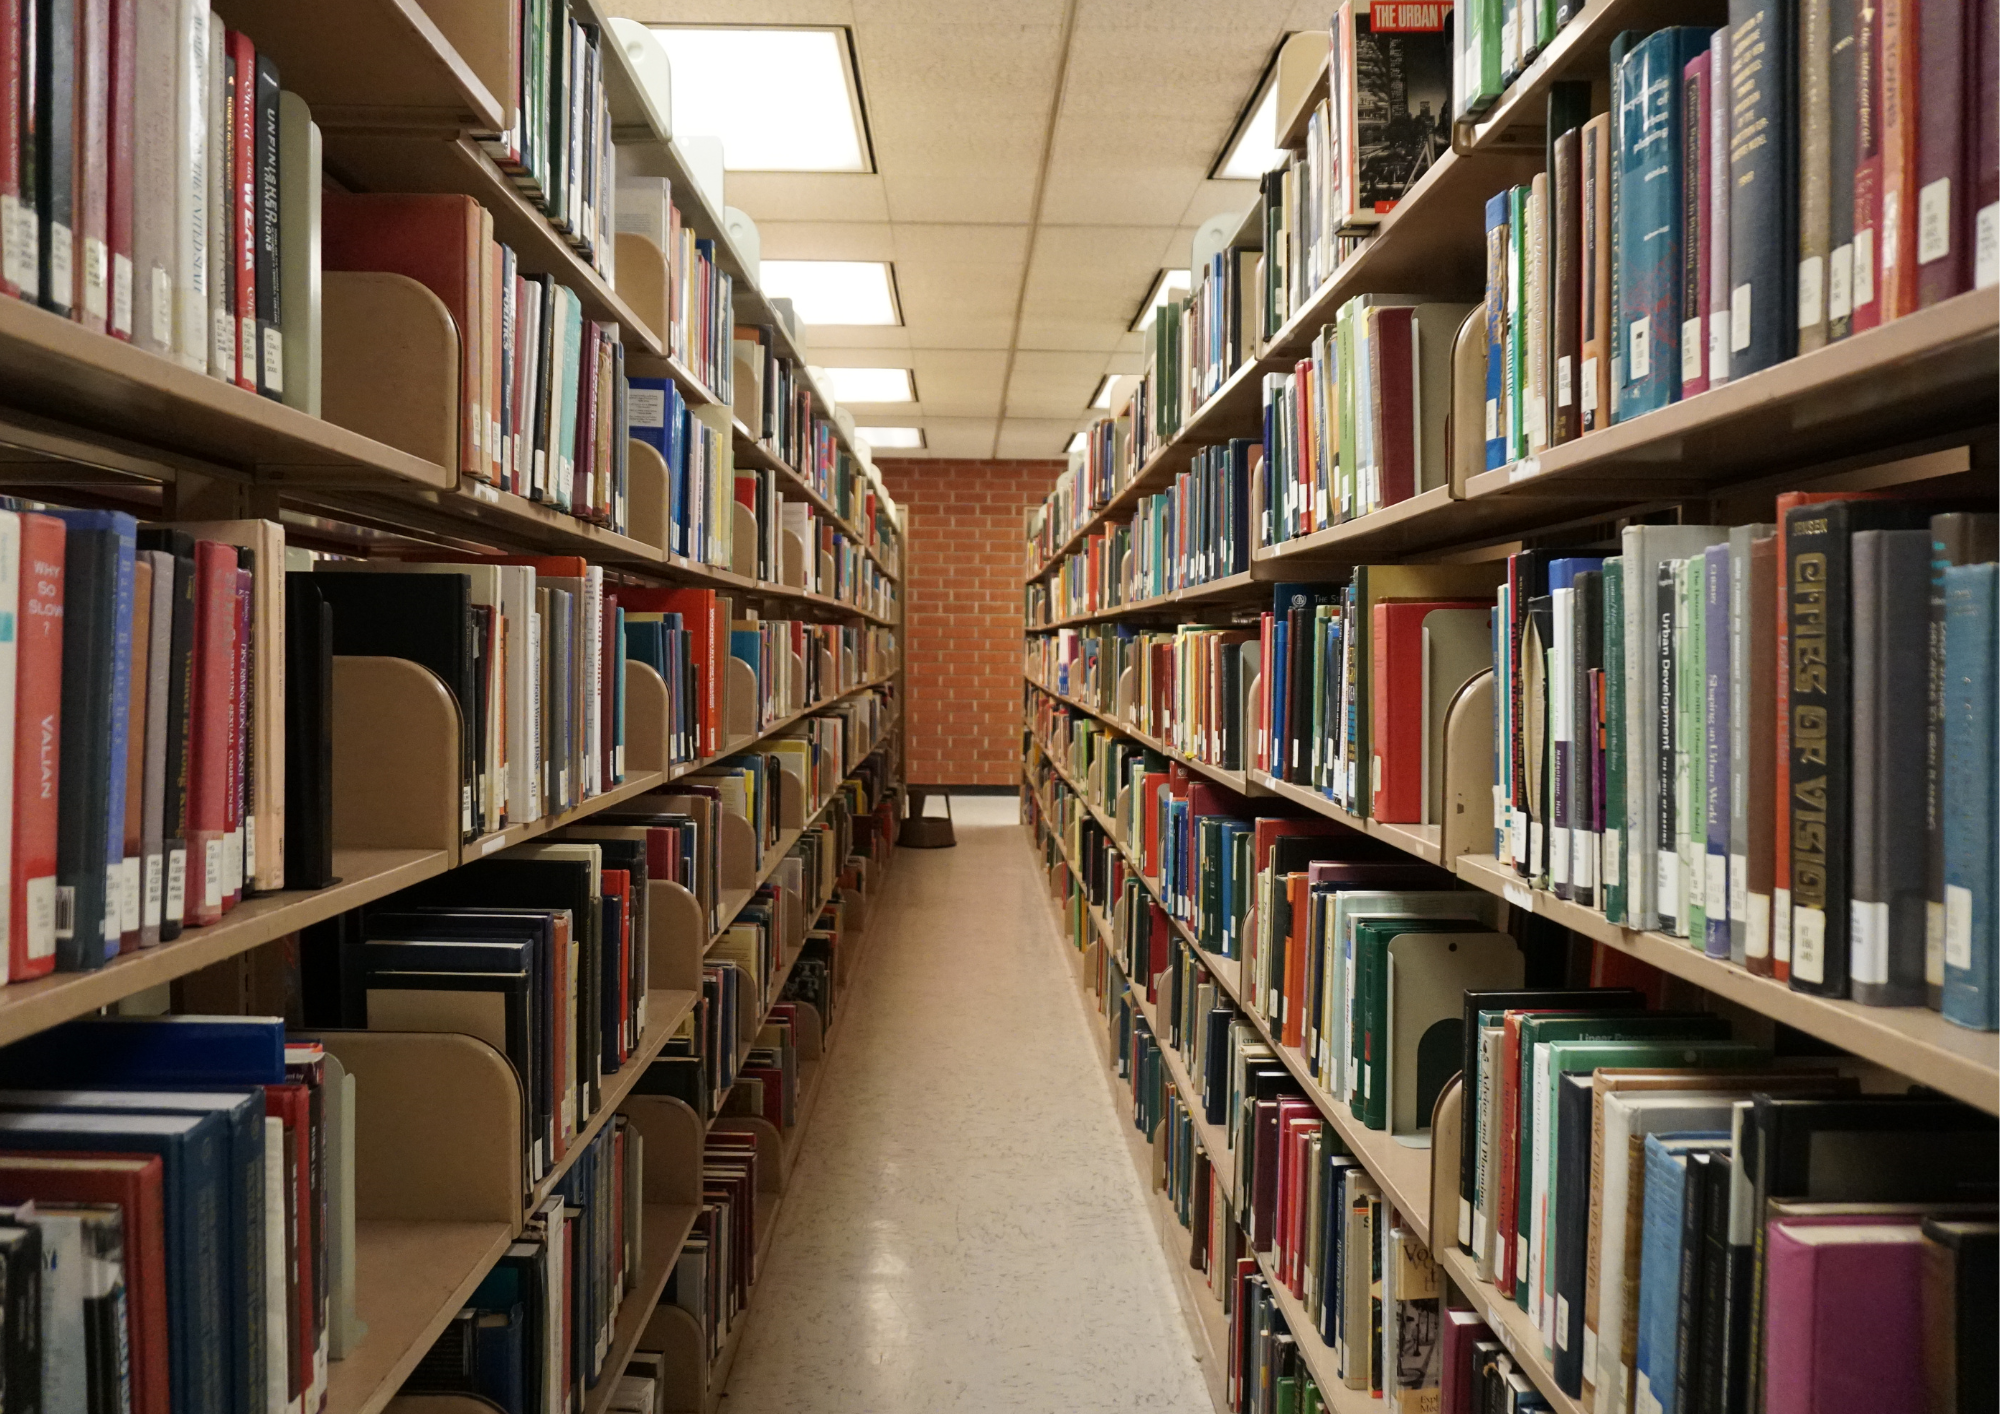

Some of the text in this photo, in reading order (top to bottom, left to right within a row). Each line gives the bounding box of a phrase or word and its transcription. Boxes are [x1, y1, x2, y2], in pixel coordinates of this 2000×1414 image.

[1374, 4, 1397, 27] THE
[1398, 3, 1439, 28] URBAN
[193, 162, 202, 250] THE UNITED
[267, 108, 277, 222] UNFINISHED
[244, 183, 254, 270] WEAK
[264, 165, 272, 251] TRANSITIONS
[1687, 217, 1697, 268] Planning
[502, 286, 510, 350] POLITICS
[1792, 517, 1828, 535] JENSEN
[29, 601, 63, 617] SLOW
[34, 560, 60, 578] WHY
[38, 581, 56, 597] SO
[1314, 594, 1329, 603] THE
[43, 621, 49, 634] ?
[114, 561, 132, 745] Bare Branches
[1794, 552, 1827, 694] CITIES
[239, 644, 247, 729] DISCRIMINATION
[1661, 612, 1670, 750] Urban Development
[1694, 668, 1700, 677] of
[42, 715, 52, 799] VALIAN
[1709, 674, 1717, 824] Shaping an Urban World
[1794, 705, 1827, 766] OF
[1480, 1070, 1490, 1207] Advice and Planning
[1588, 1091, 1601, 1289] HOW CITIES ARE SAVED
